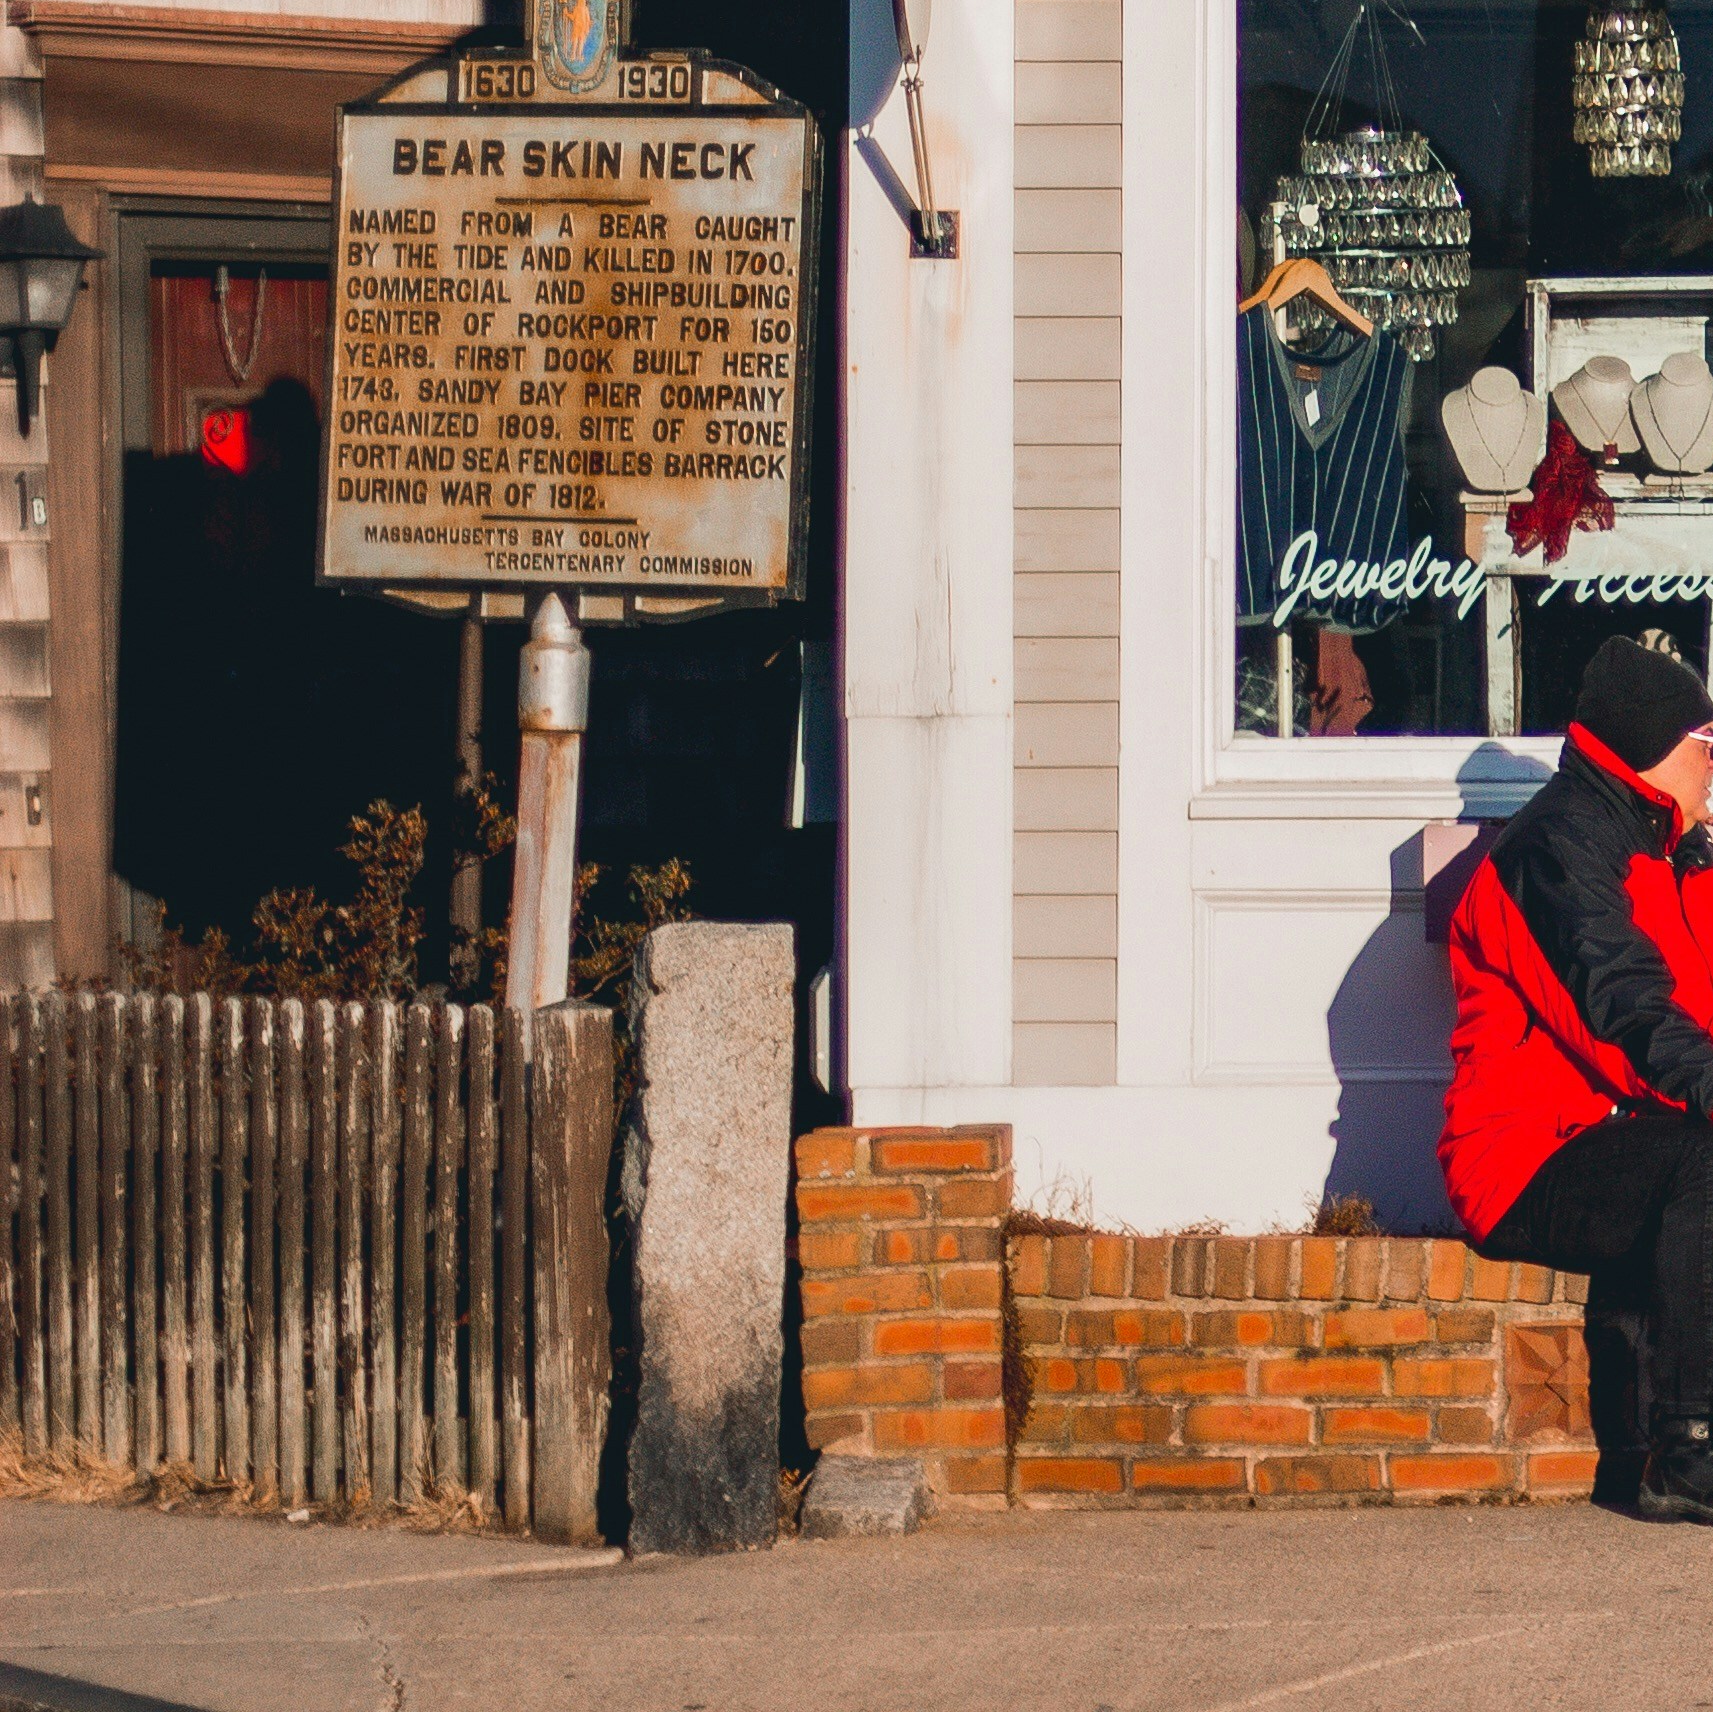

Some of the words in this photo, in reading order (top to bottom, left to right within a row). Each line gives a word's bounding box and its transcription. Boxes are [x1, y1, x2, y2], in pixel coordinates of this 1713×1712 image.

[465, 65, 535, 99] 1630
[617, 66, 689, 100] 1930
[393, 139, 505, 176] BEAR
[523, 140, 623, 179] SKIN
[640, 142, 755, 181] NECK
[349, 210, 436, 235] NAMED
[460, 211, 533, 237] FROM
[558, 213, 573, 237] A
[600, 214, 667, 240] BEAR
[695, 216, 795, 242] CAUGHT
[348, 243, 380, 267] BY
[392, 244, 442, 269] THE
[454, 246, 508, 270] TIDE
[520, 247, 572, 271] AND
[583, 249, 675, 273] KILLED
[688, 250, 713, 274] IN
[725, 251, 795, 276] 1700.
[346, 278, 510, 303] COMMERCIAL
[535, 281, 585, 305] AND
[611, 282, 790, 309] SHIPBUILDING
[345, 310, 441, 335] CENTER
[463, 313, 495, 336] OF
[518, 314, 658, 341] ROCKPORT
[680, 317, 730, 342] FOR
[344, 343, 435, 369] YEARS.
[455, 345, 526, 370] FIRST
[544, 348, 613, 373] DOCK
[633, 350, 702, 376] BUILT
[722, 352, 789, 379] HERE
[418, 380, 501, 405] SANDY
[519, 382, 568, 407] BAY
[584, 384, 641, 409] PIER
[660, 385, 785, 411] COMPANY
[340, 410, 479, 438] ORGANIZED
[498, 415, 561, 439] 1809.
[580, 417, 632, 442] SITE
[652, 419, 684, 443] OF
[706, 419, 787, 446] STONE
[338, 444, 398, 469] FORT
[406, 446, 456, 471] AND
[462, 448, 510, 473] SEA
[518, 449, 653, 477] FENCIBLES
[665, 453, 786, 480] BARRACK
[338, 478, 427, 504] DURING
[441, 481, 492, 507] WAR
[504, 484, 535, 508] OF
[549, 485, 605, 510] 1812.
[365, 525, 519, 546] MASSACHUSETTS
[532, 527, 564, 548] BAY
[579, 529, 650, 549] COLONY
[485, 551, 625, 573] TERCENTENARY
[640, 555, 753, 577] COMMISSION
[1274, 529, 1488, 628] Jewelry
